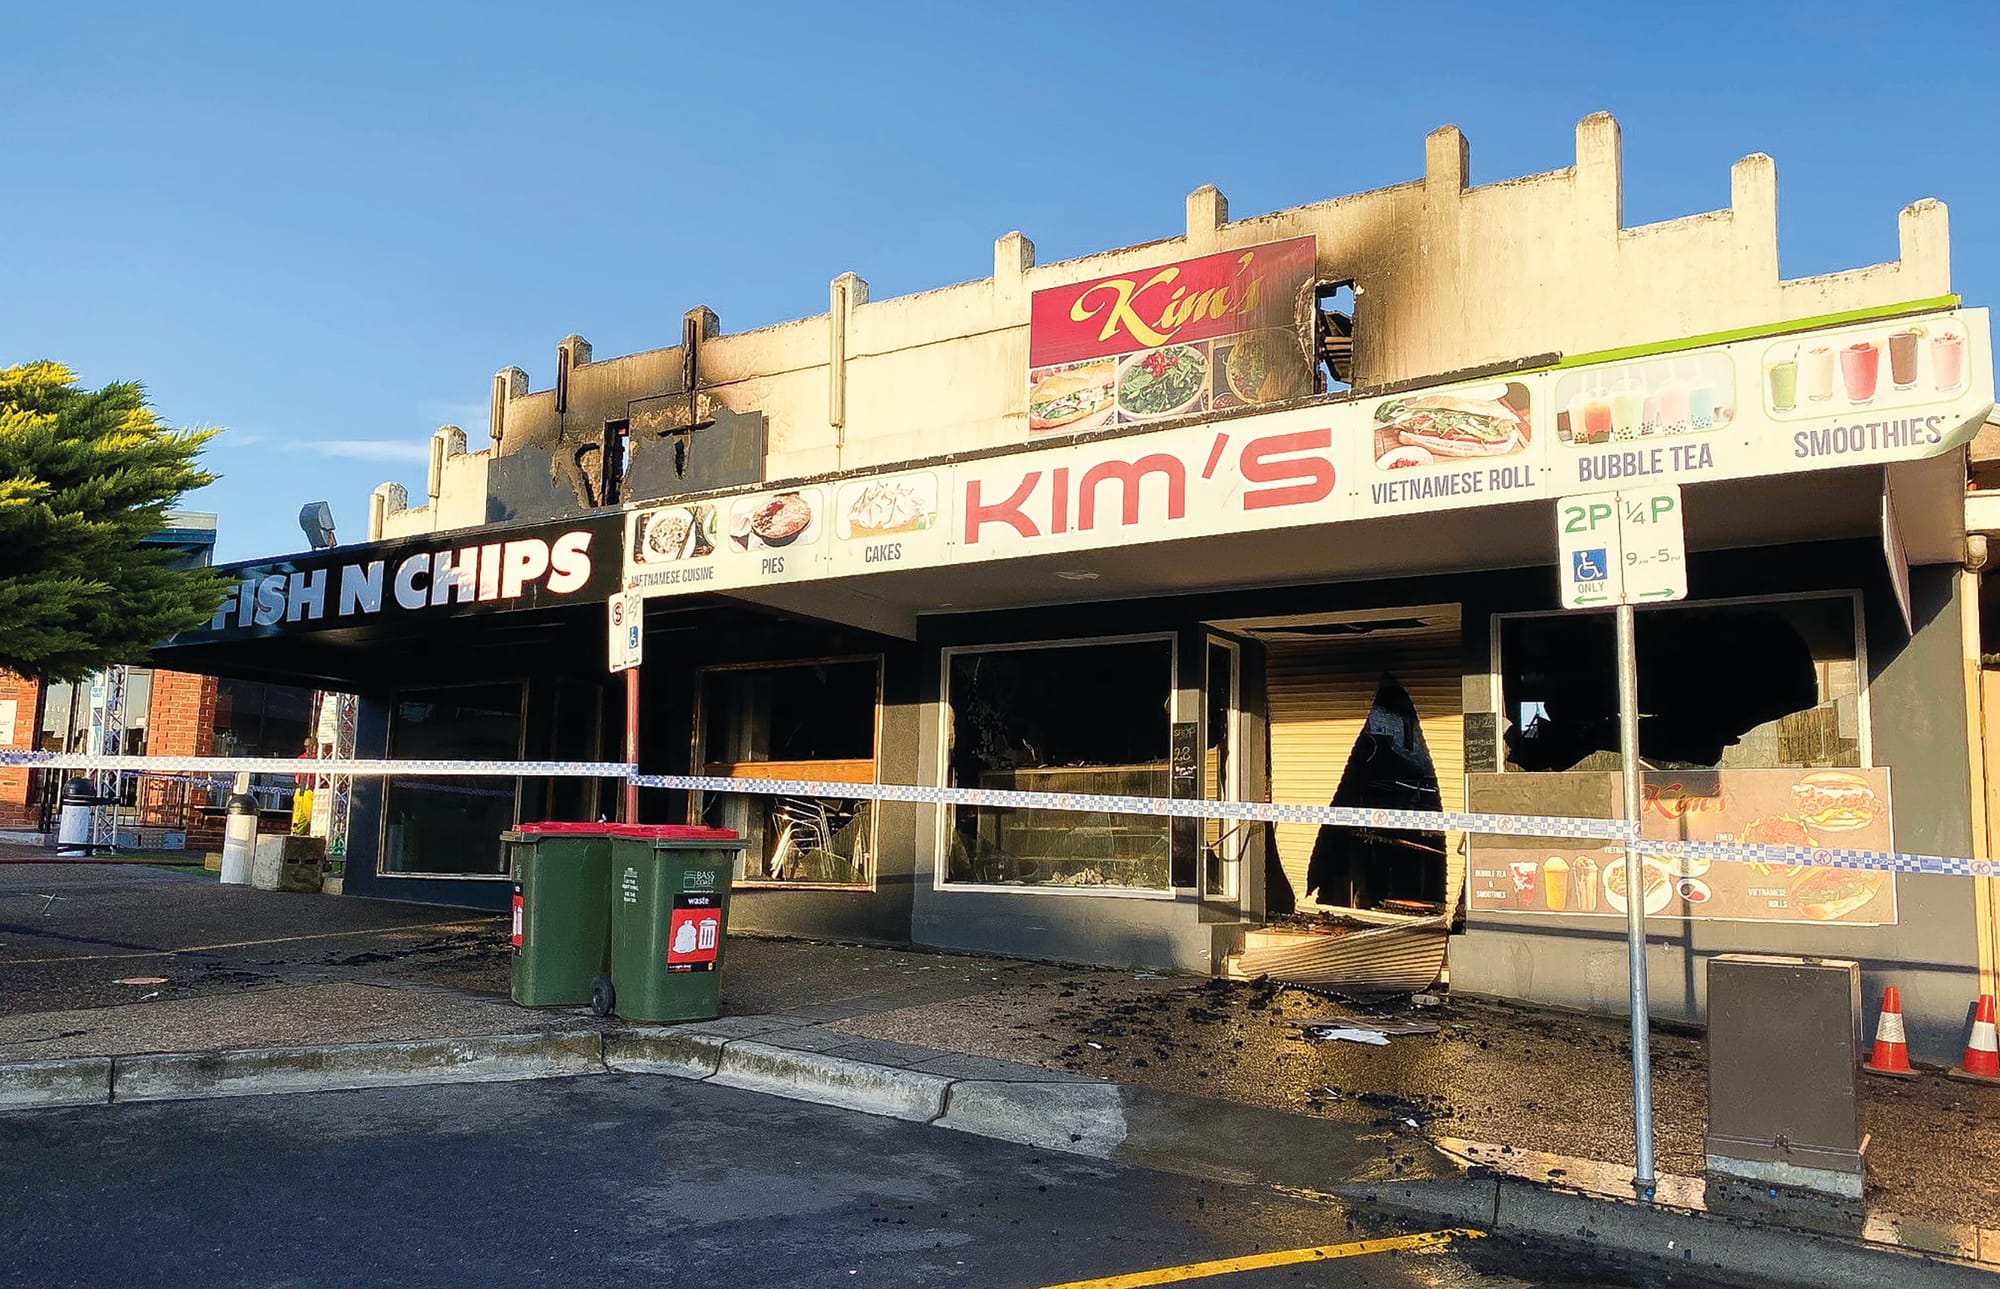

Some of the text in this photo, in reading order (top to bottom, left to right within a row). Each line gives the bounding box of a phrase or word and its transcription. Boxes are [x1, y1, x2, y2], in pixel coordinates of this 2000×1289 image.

[1070, 252, 1264, 347] Kim's
[1794, 416, 1942, 458] SMOOTHIES
[1579, 443, 1713, 482] BUBBLE TEA
[1372, 465, 1535, 504] VIETNAMESE ROLL
[1565, 504, 1612, 533] 2P
[865, 543, 901, 563] CAKES
[682, 566, 714, 582] CUISINE
[762, 557, 784, 574] PIES
[211, 531, 593, 630] FISH N CHIPS
[1578, 582, 1604, 594] ONLY
[1174, 746, 1191, 761] 28
[697, 871, 715, 880] BASS
[688, 896, 710, 905] waste
